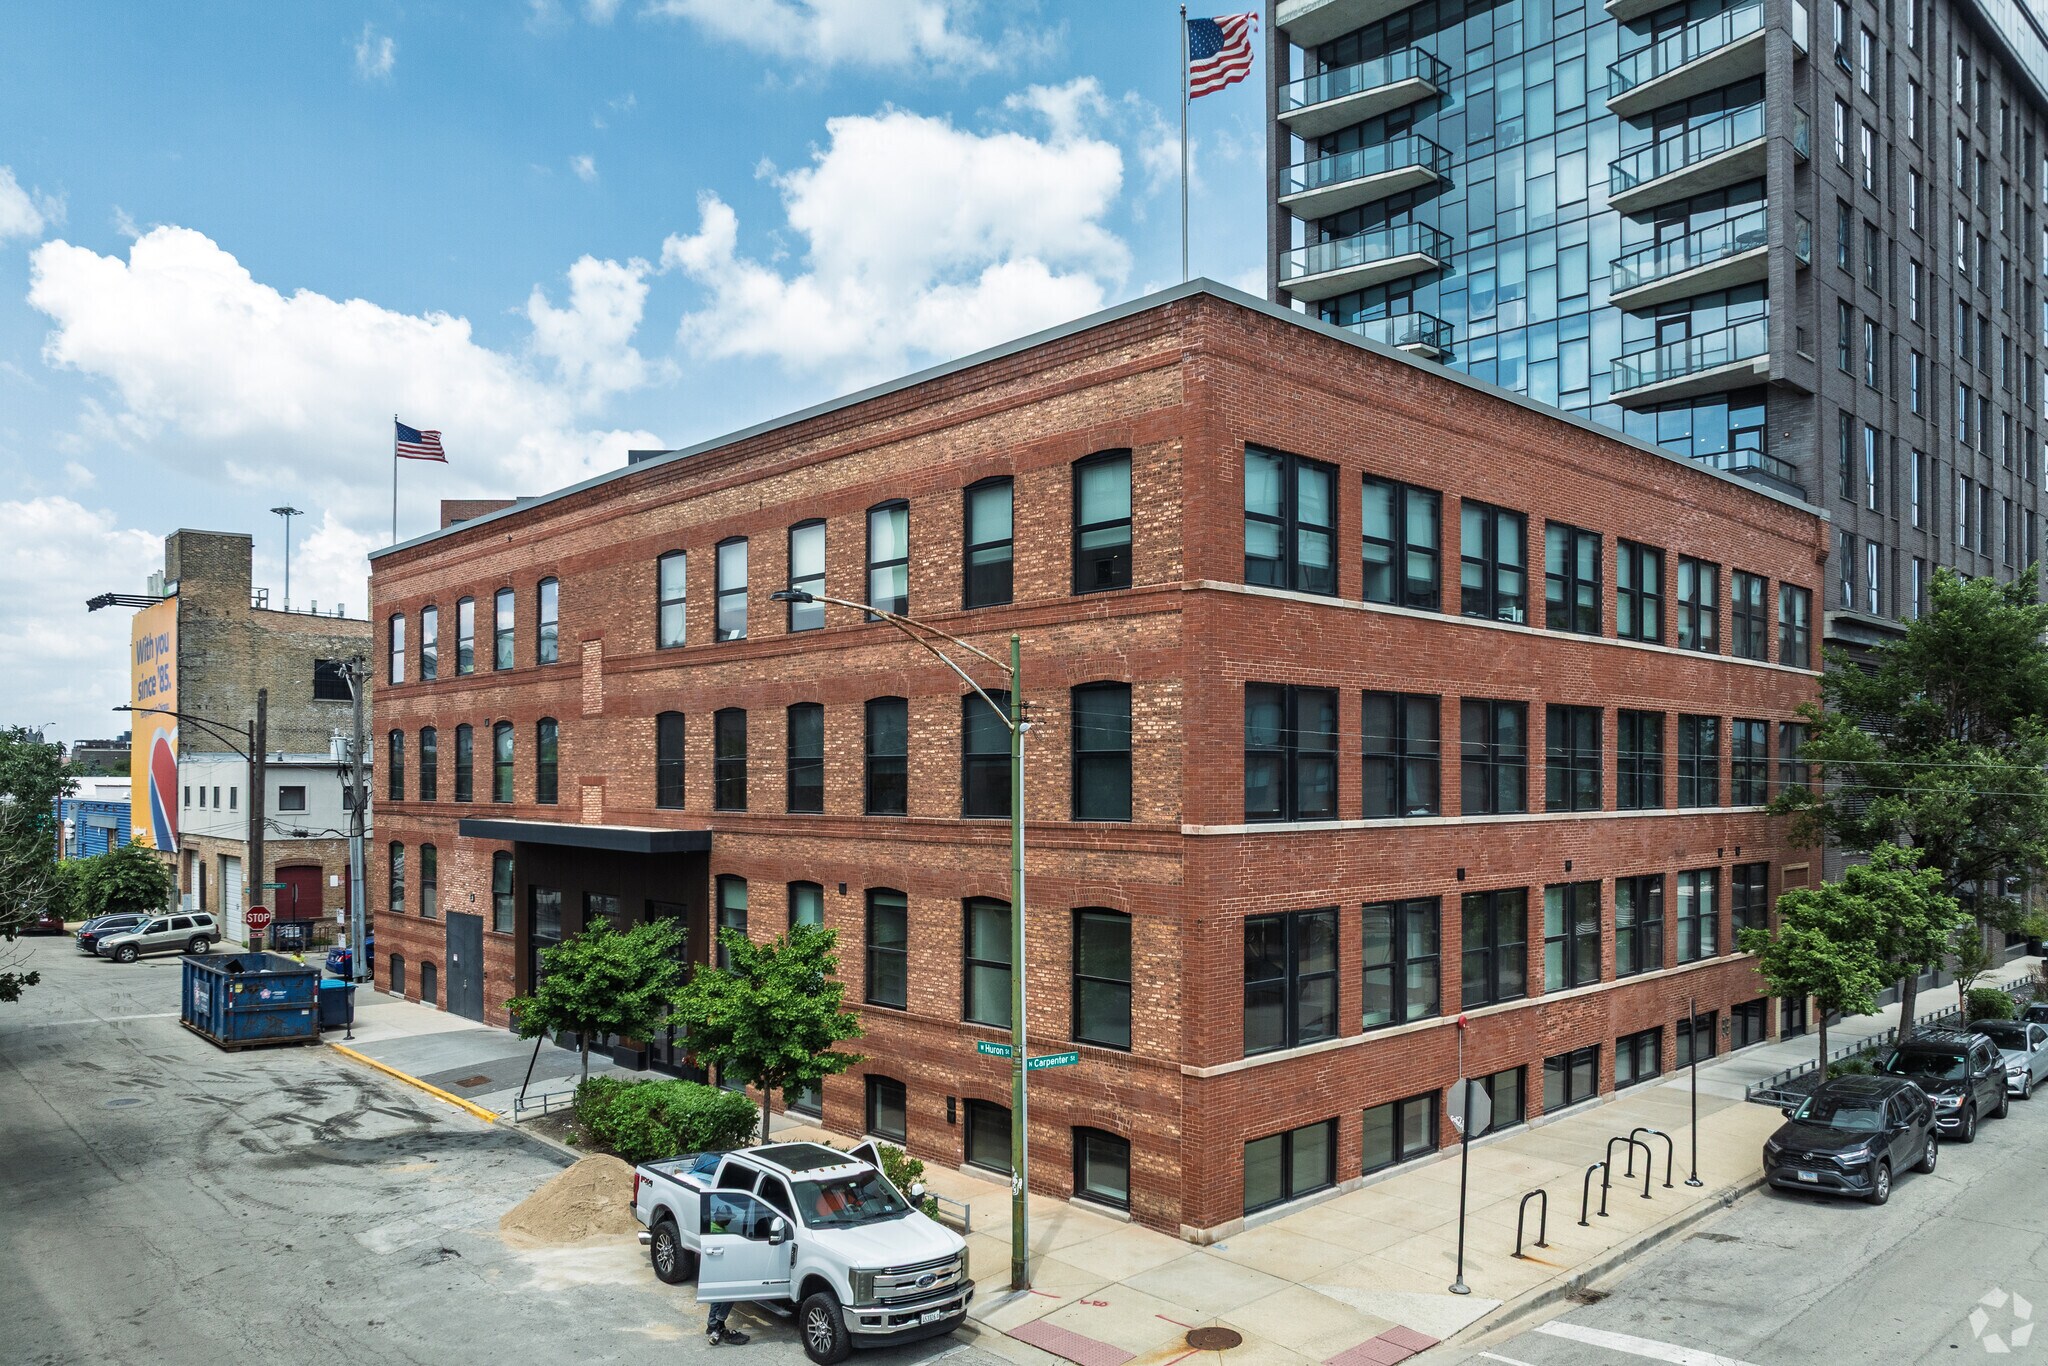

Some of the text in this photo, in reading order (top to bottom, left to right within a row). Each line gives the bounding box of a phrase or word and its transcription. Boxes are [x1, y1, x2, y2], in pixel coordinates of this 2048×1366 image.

[136, 632, 169, 666] With you
[138, 673, 156, 701] since
[247, 913, 270, 923] STOP
[985, 1044, 1004, 1055] Huron
[1034, 1056, 1068, 1068] Carpenter
